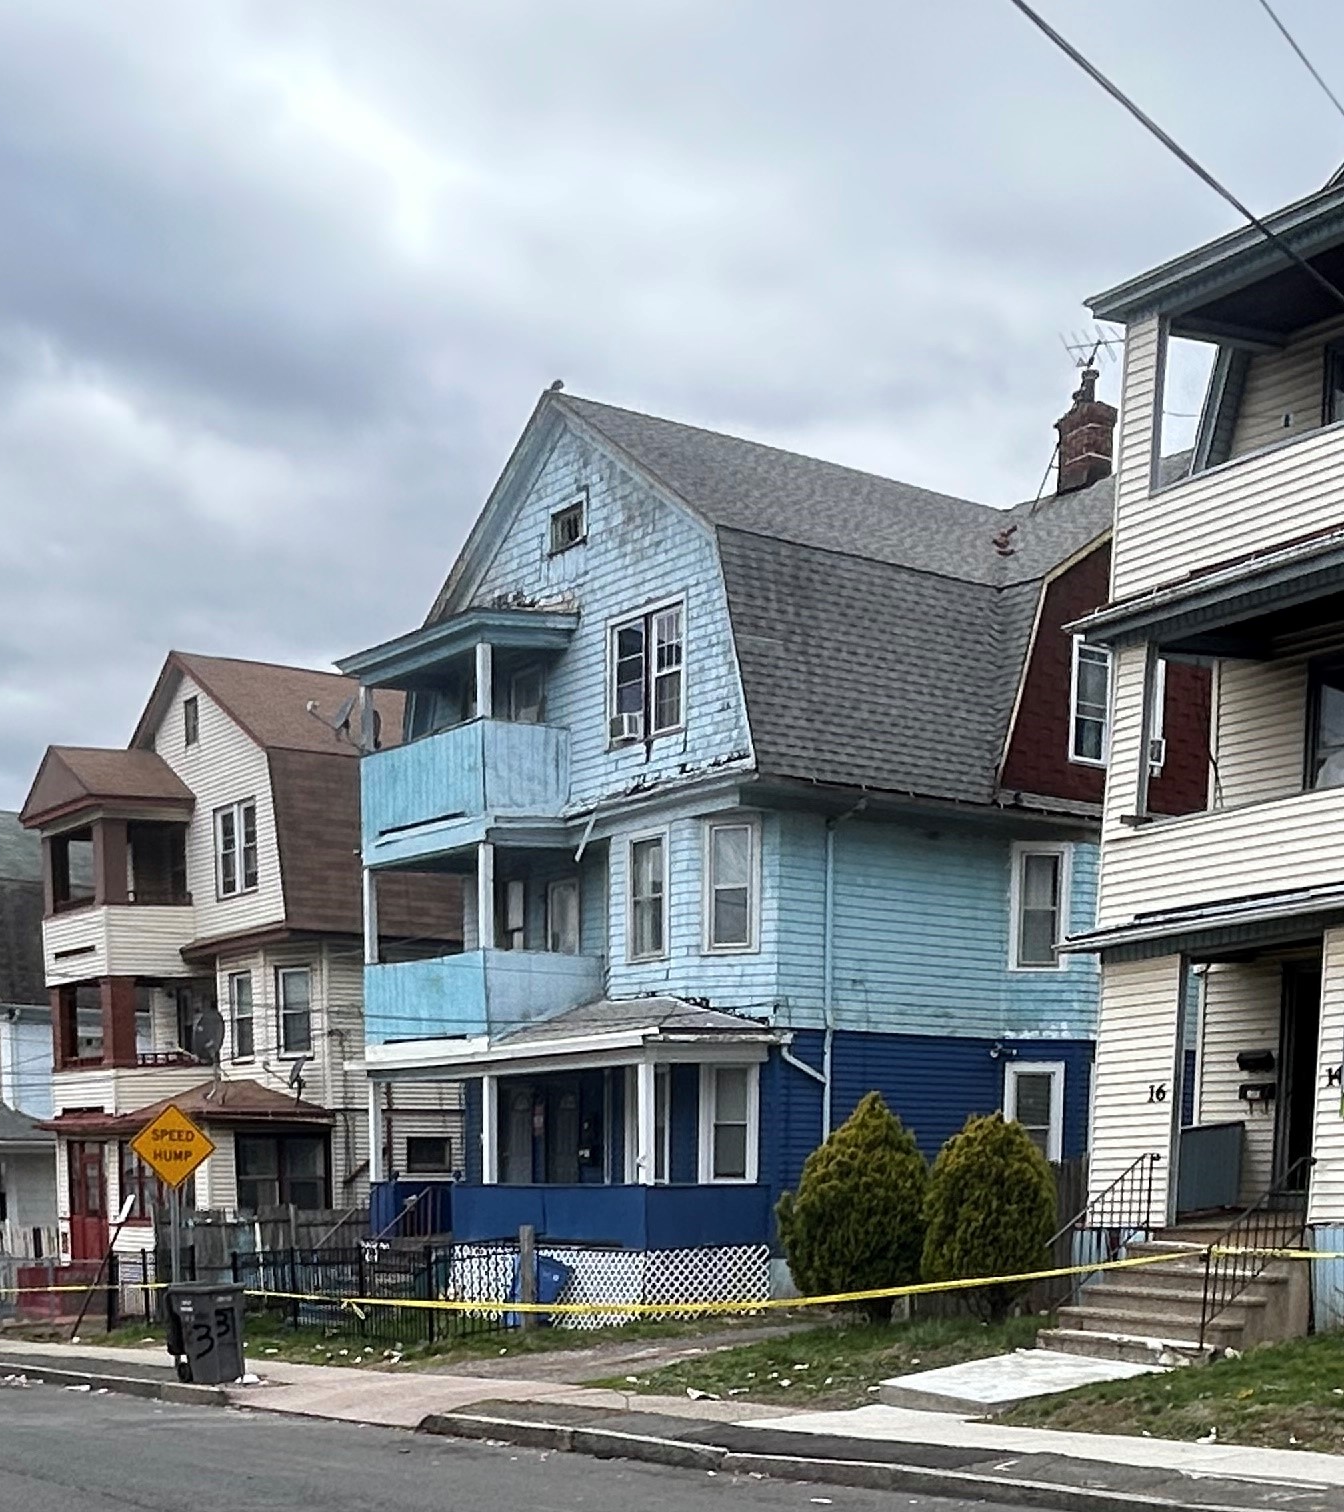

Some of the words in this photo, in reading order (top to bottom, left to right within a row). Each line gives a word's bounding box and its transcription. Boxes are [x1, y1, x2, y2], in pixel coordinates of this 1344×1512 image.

[1146, 1082, 1168, 1104] 16
[151, 1128, 195, 1142] SPEED
[152, 1149, 193, 1162] HUMP
